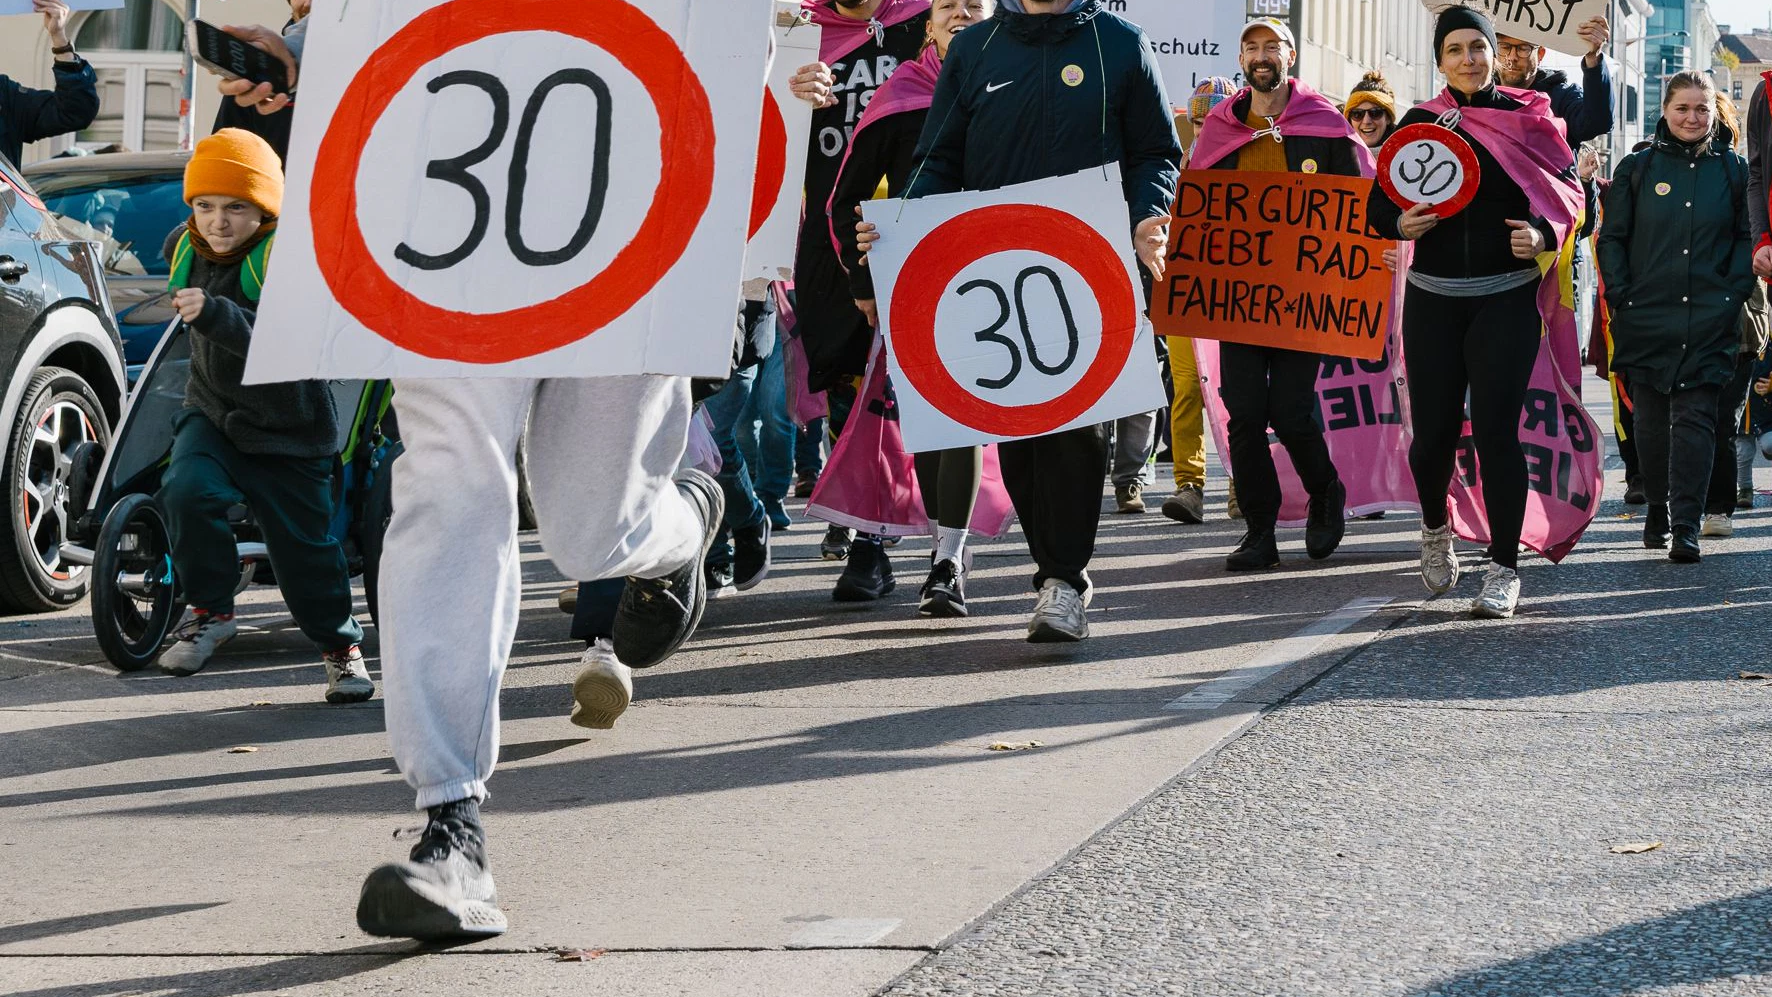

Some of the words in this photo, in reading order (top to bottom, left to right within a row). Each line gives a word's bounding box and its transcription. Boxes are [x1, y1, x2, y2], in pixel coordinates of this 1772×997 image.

[1150, 37, 1220, 56] schutz
[395, 68, 612, 270] 30
[1398, 142, 1457, 196] 30
[1176, 182, 1249, 222] DER
[1296, 235, 1382, 280] RAD-
[956, 266, 1078, 389] 30
